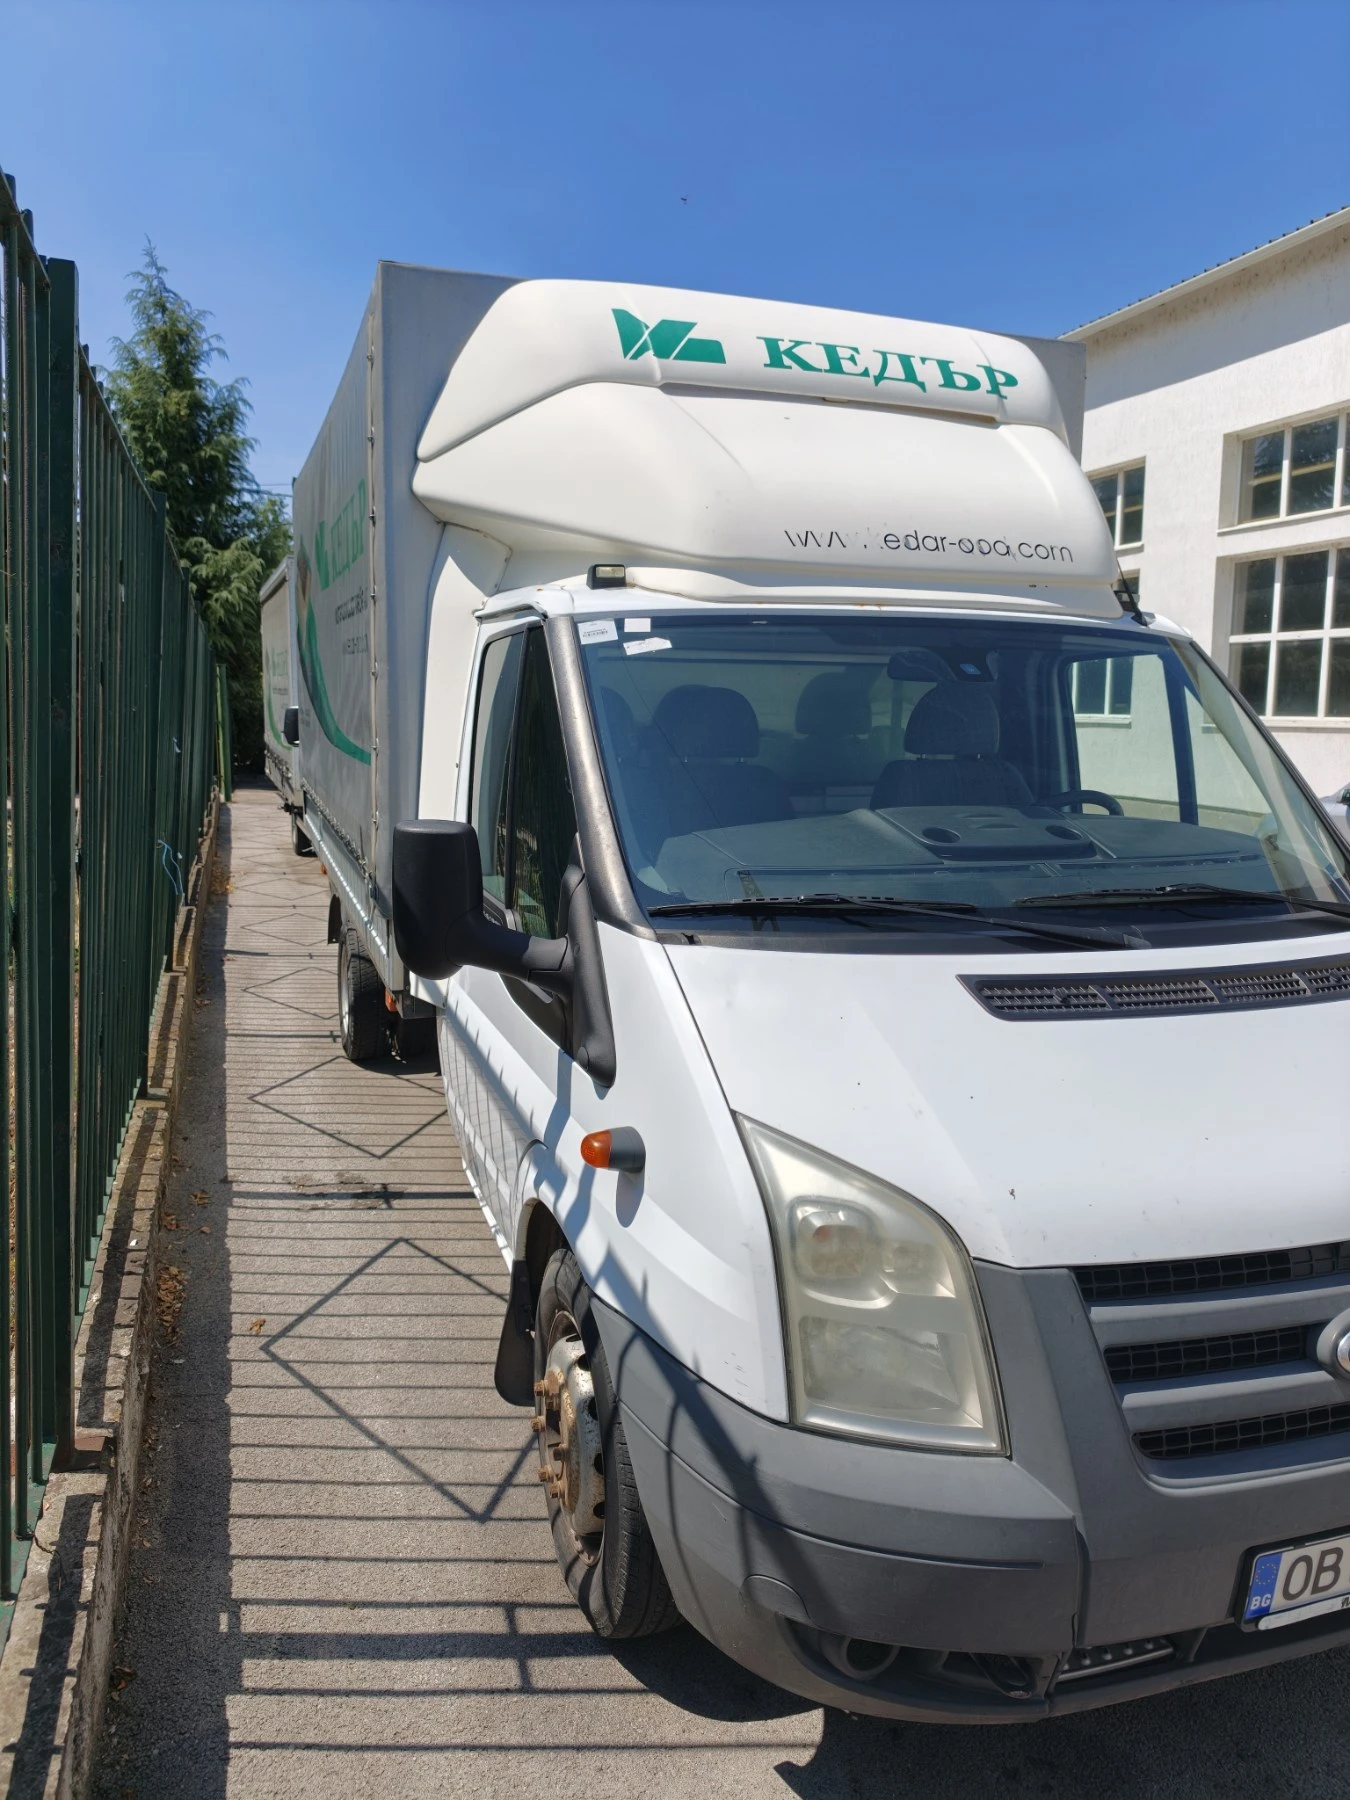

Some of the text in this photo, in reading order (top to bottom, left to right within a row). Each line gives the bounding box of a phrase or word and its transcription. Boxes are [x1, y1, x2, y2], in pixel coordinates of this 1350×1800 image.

[757, 337, 1018, 399] КЕДЪР
[1283, 1547, 1344, 1601] OB
[1250, 1594, 1272, 1610] BG
